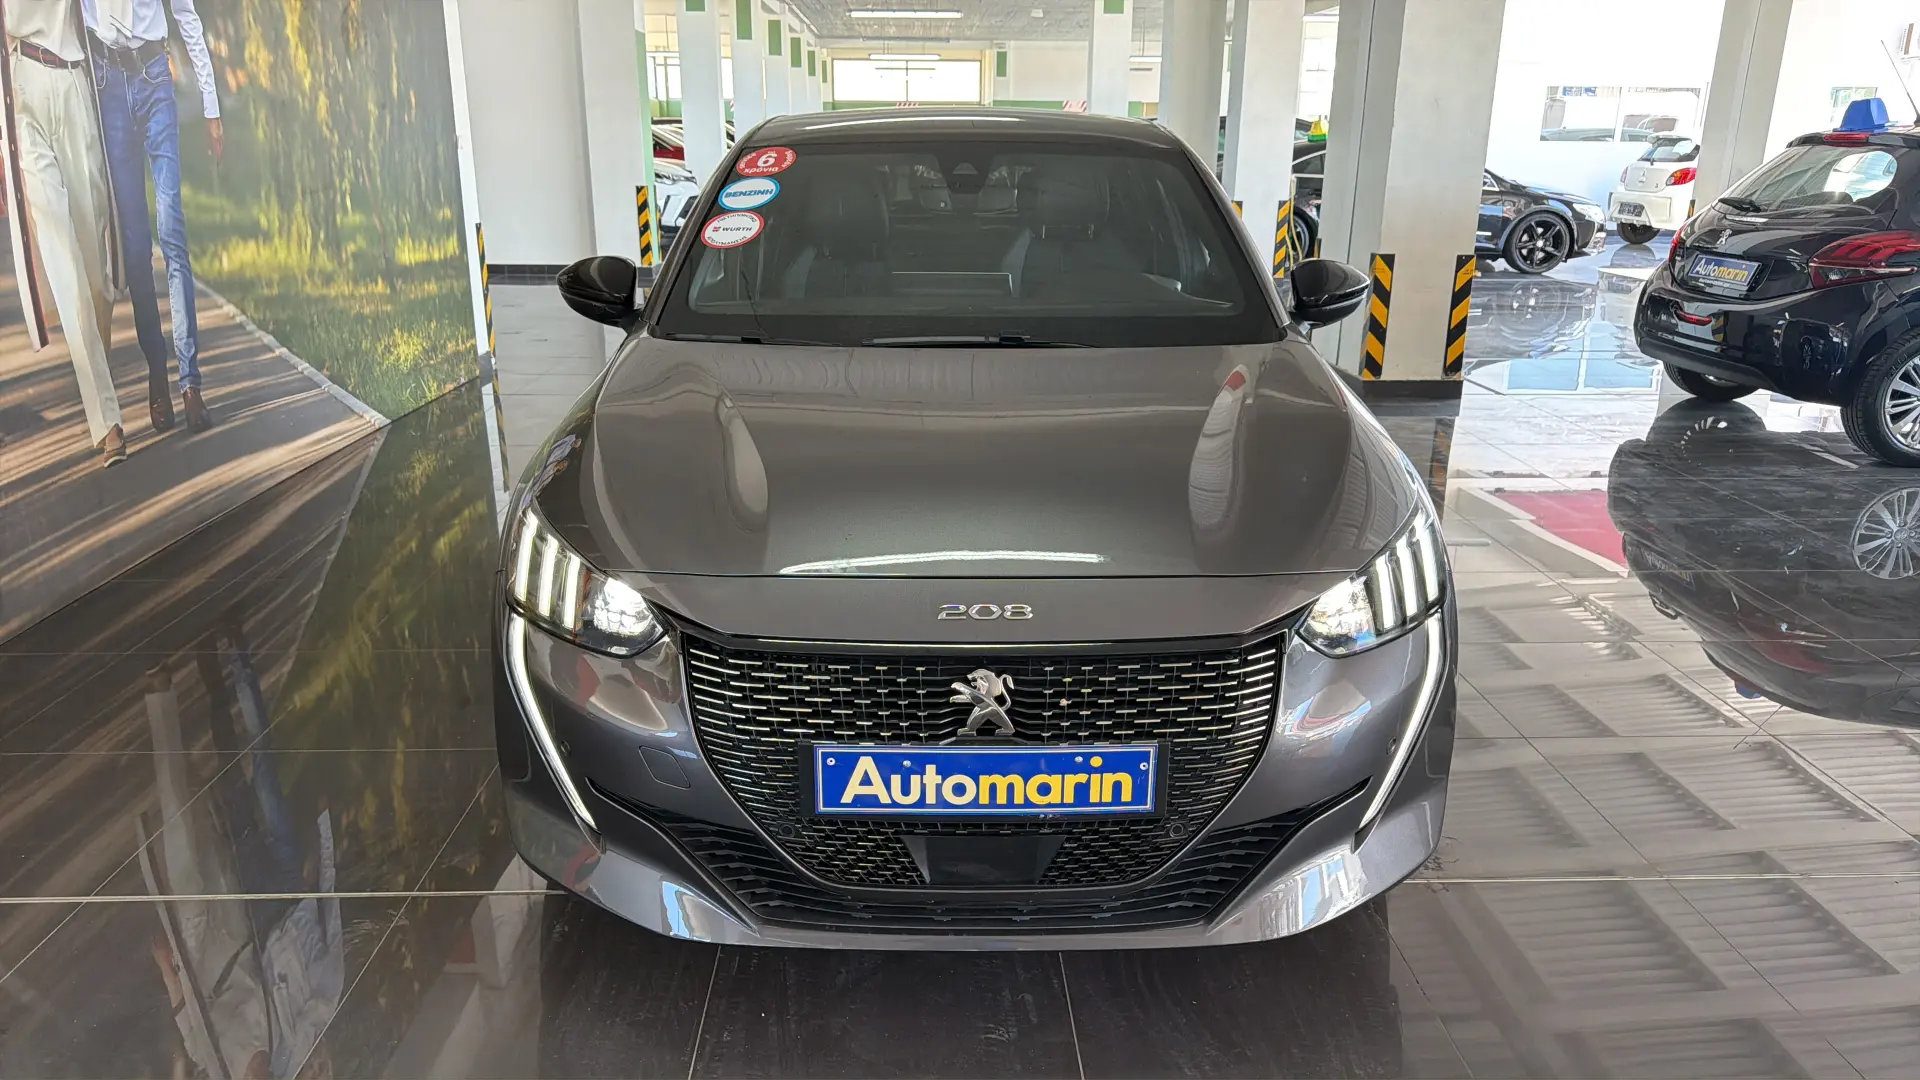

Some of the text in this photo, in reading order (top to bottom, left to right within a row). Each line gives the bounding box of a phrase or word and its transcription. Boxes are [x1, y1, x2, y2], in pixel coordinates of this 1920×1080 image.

[757, 153, 778, 167] 6
[1693, 258, 1749, 282] Automarin
[937, 603, 1034, 620] 208
[840, 755, 1133, 806] Automarin
